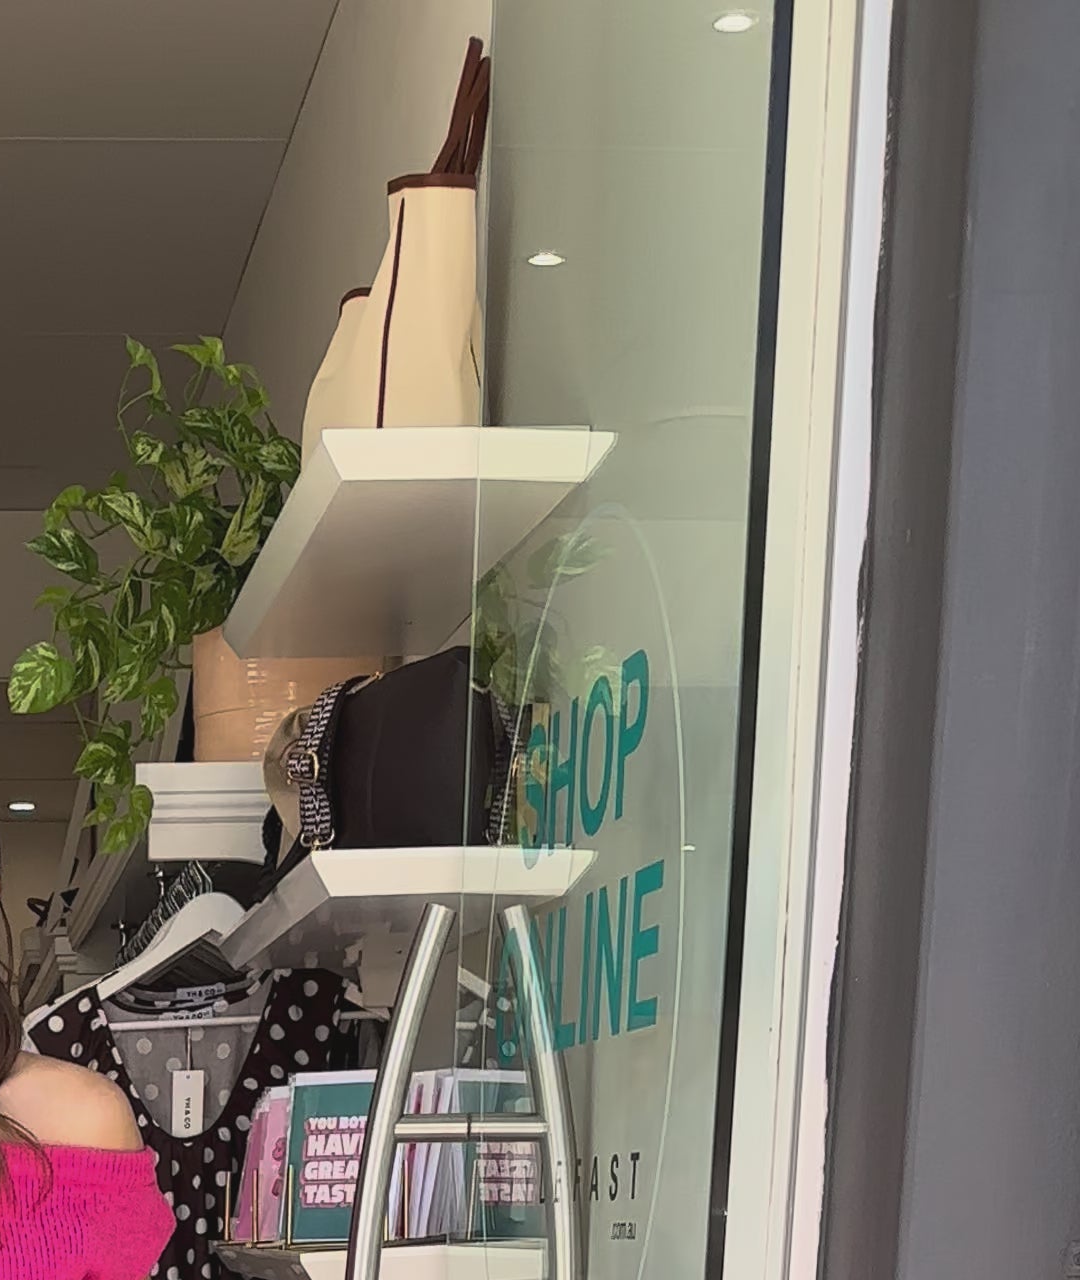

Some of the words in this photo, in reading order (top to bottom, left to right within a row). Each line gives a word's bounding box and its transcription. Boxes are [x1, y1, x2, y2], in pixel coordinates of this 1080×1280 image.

[521, 648, 651, 870] SHOP
[307, 1116, 337, 1131] YOU
[338, 1115, 368, 1130] BOT
[304, 1159, 360, 1181] GREA
[304, 1183, 357, 1204] TAST
